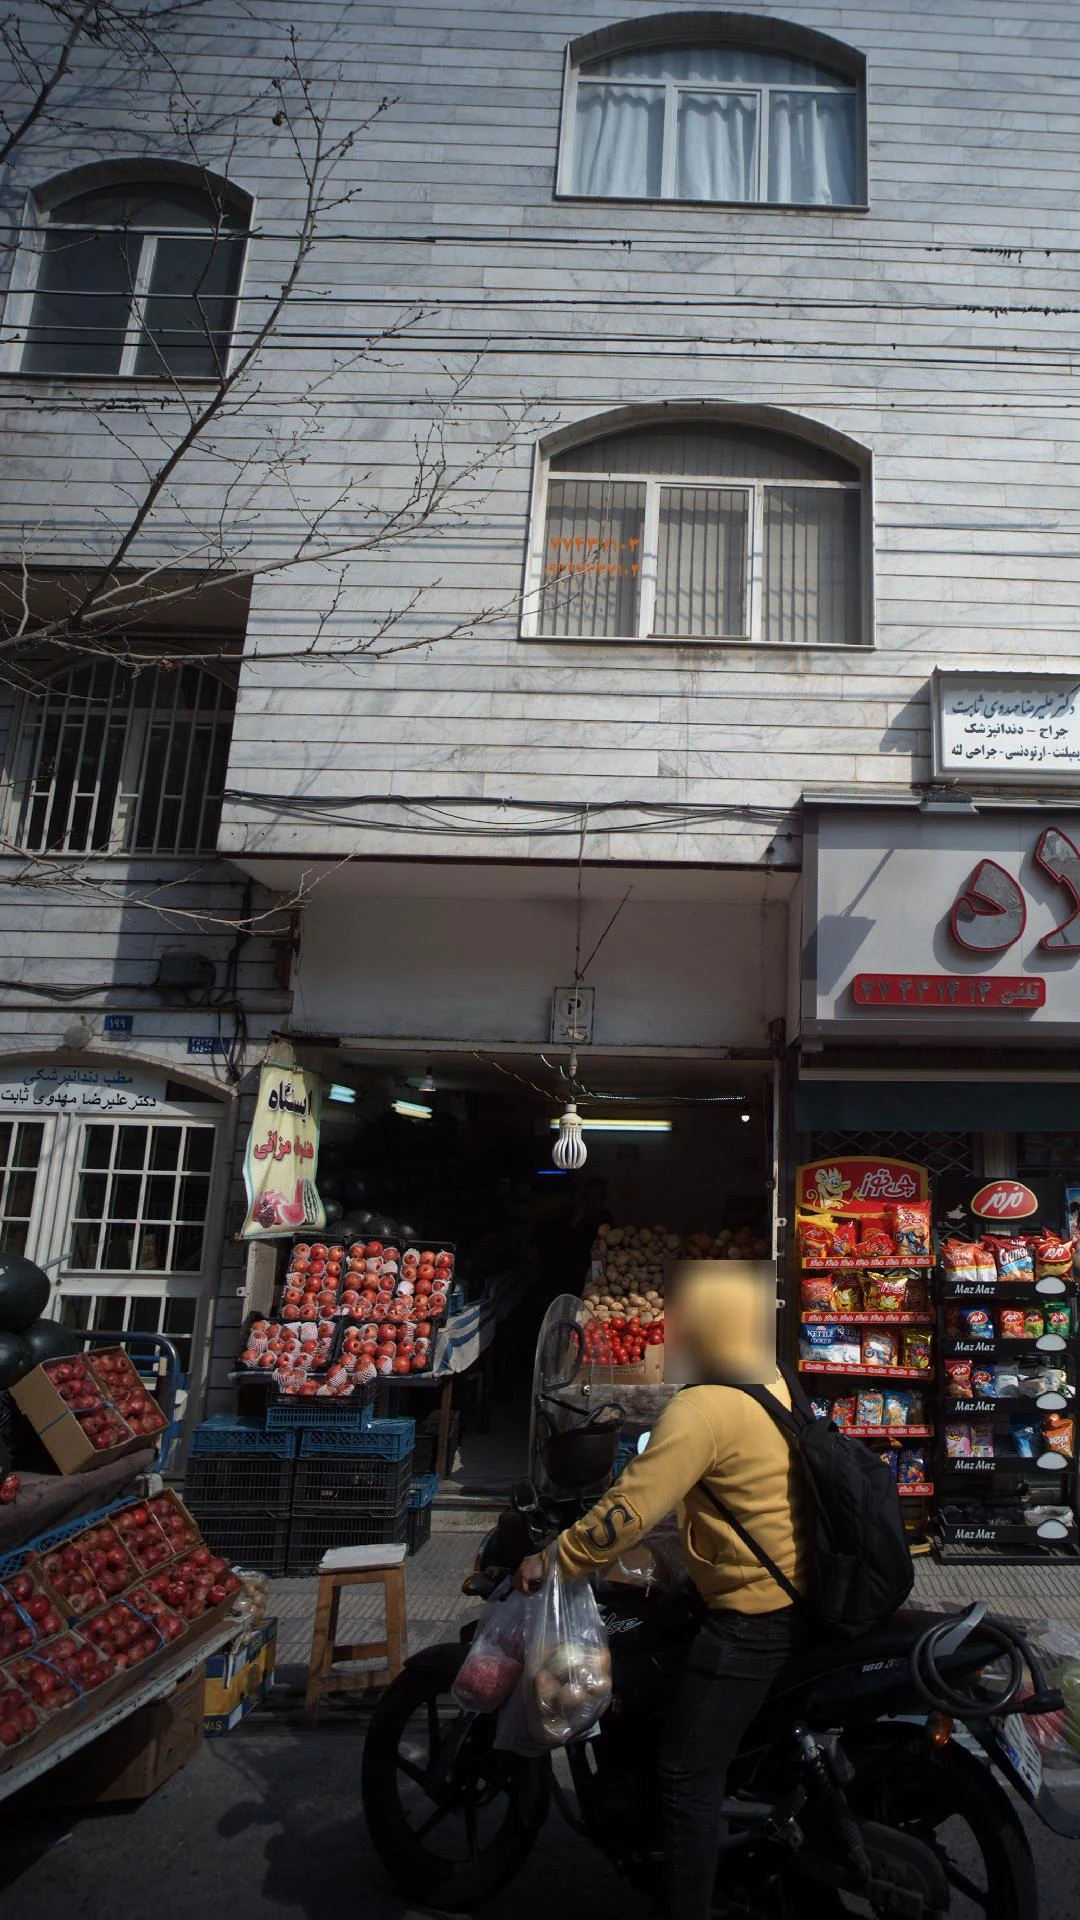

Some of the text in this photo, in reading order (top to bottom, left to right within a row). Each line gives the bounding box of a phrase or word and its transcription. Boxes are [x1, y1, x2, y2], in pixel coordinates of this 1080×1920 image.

[952, 683, 1080, 720] دکتر علیرضا مهدوی ثابت
[964, 723, 1069, 740] جراح دندانپزشک
[952, 743, 963, 756] لثه
[966, 744, 997, 760] جراحی
[1005, 746, 1046, 761] ارتودنسی
[110, 1018, 126, 1029] ۱۹۹
[24, 1067, 134, 1088] مطب دندانپزشکی
[1, 1087, 157, 1110] دکتر علیرضا مهدوی ثابت
[954, 1283, 996, 1294] Maz Maz
[954, 1341, 996, 1352] Maz Maz
[954, 1401, 996, 1411] Maz Maz
[954, 1460, 996, 1470] Maz Maz
[954, 1529, 996, 1539] Maz Maz
